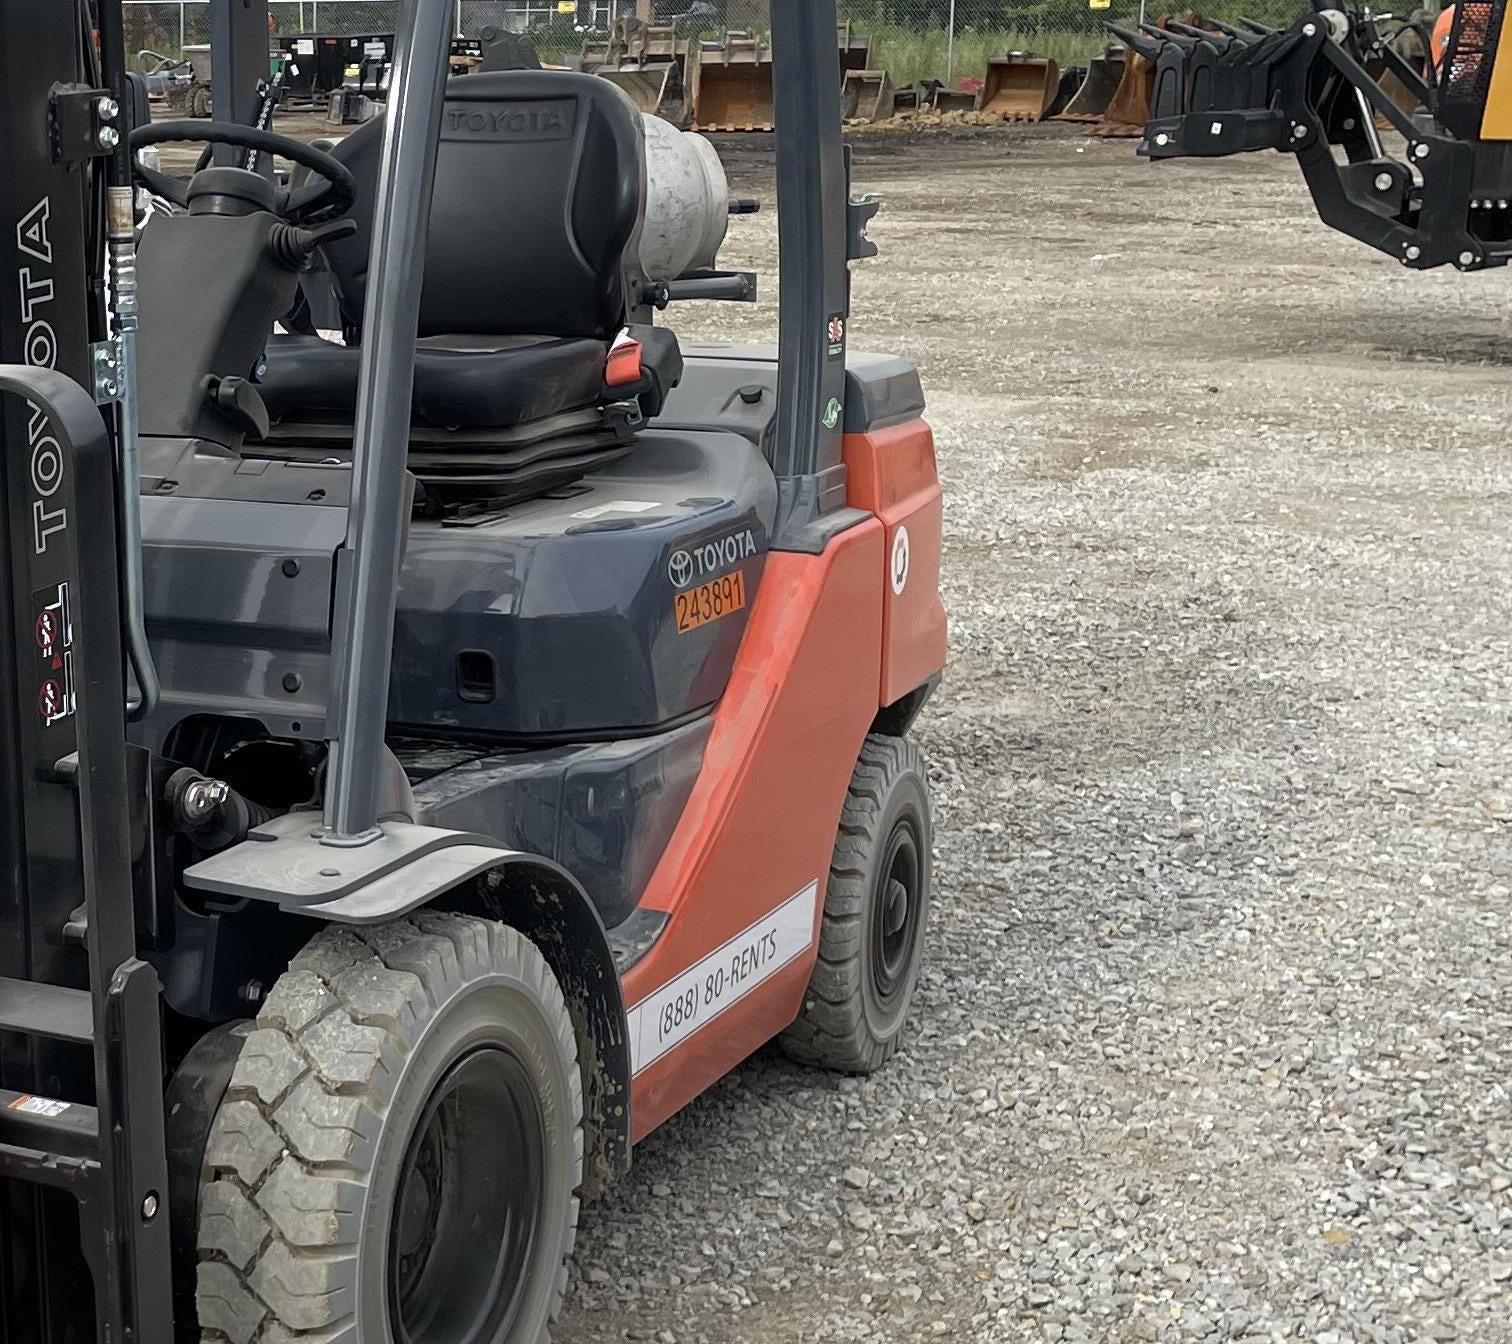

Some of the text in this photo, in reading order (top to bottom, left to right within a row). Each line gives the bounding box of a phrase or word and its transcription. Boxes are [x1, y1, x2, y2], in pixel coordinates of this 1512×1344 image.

[693, 529, 757, 575] TOYOTA
[677, 573, 742, 631] 243891
[658, 928, 777, 1043] (888) 80-RENTS
